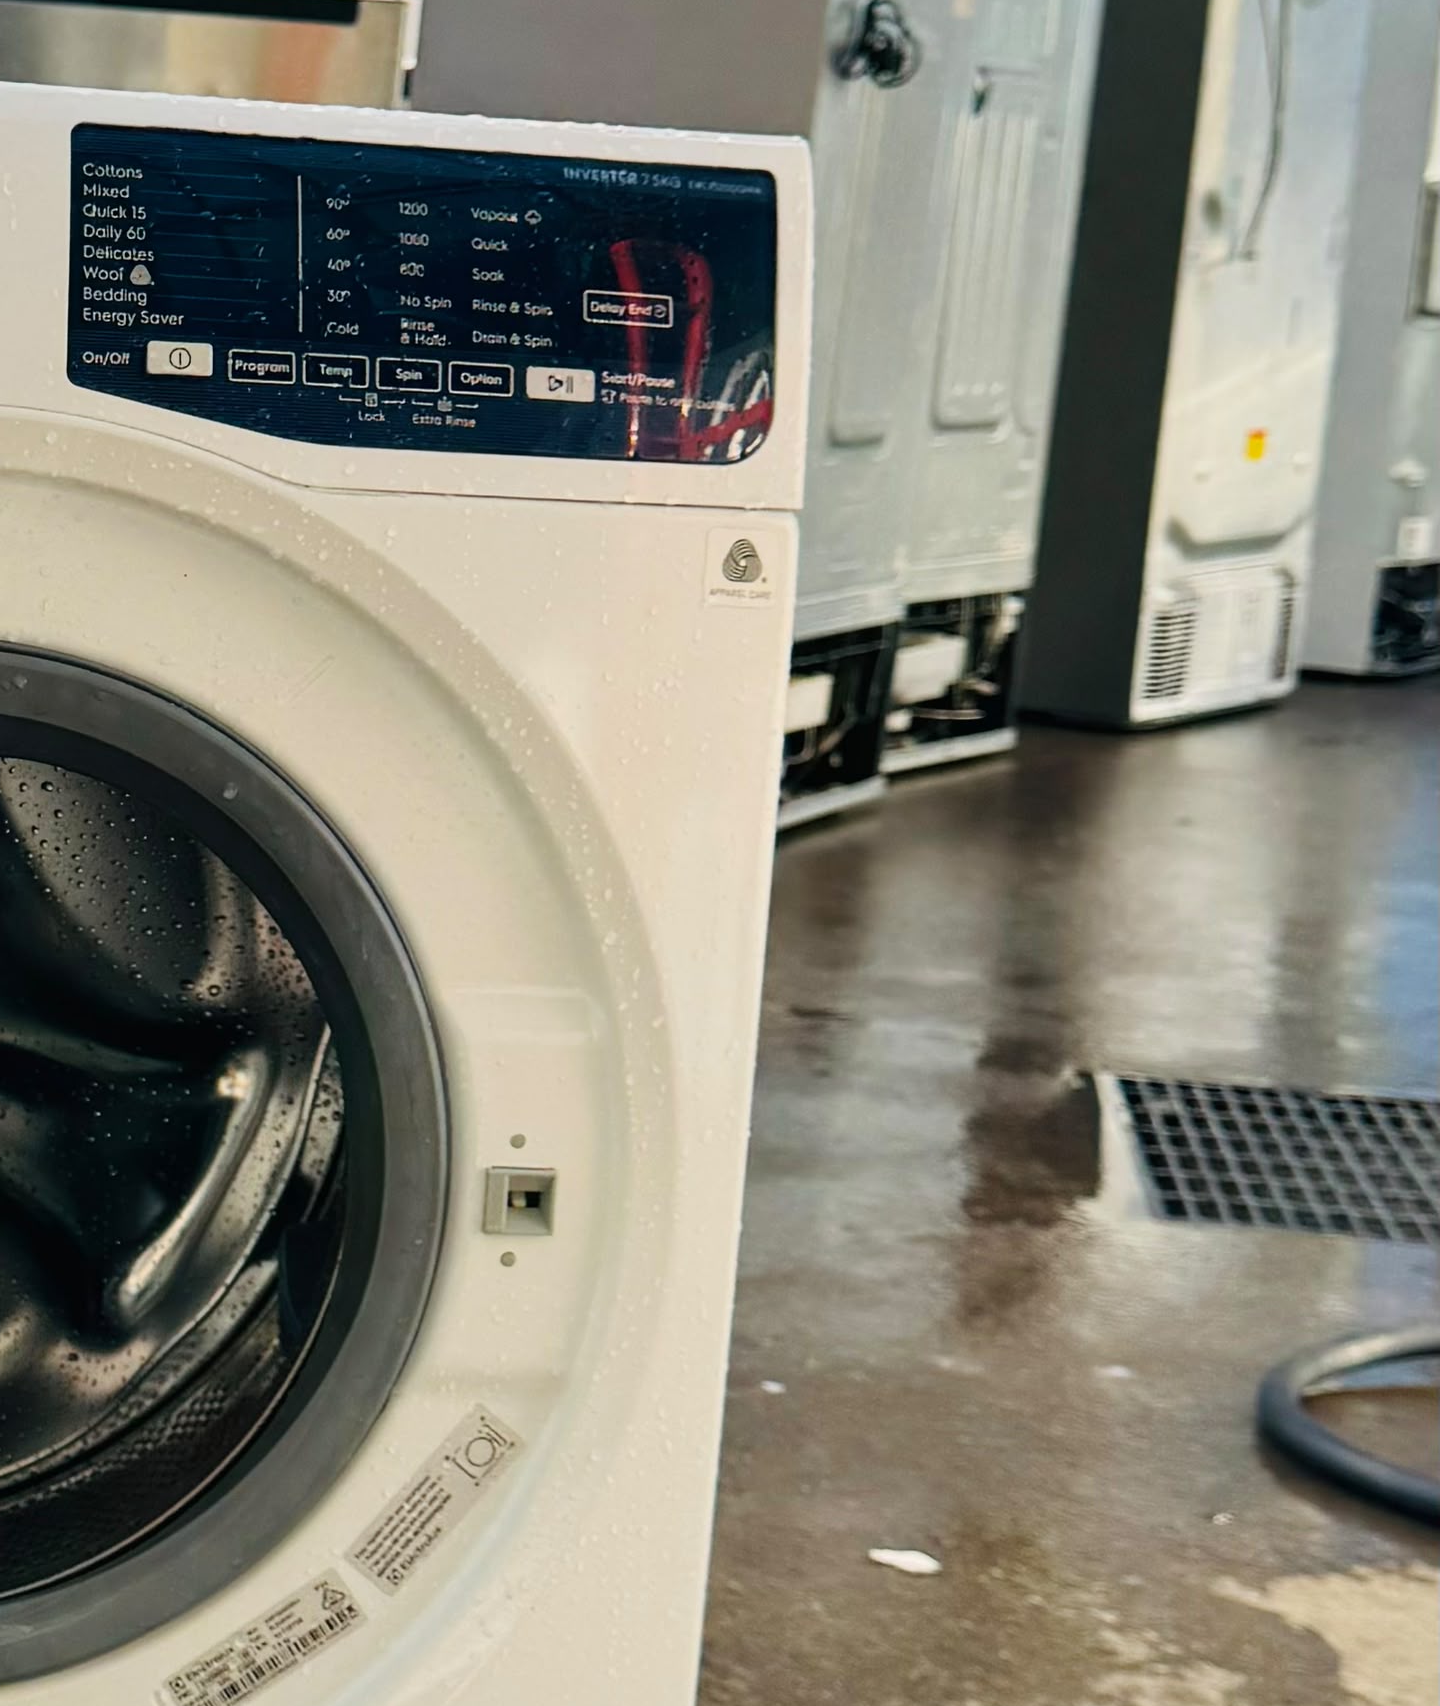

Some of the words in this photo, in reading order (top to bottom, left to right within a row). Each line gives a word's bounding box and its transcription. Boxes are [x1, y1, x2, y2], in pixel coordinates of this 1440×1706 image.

[82, 162, 143, 179] Cottons
[83, 184, 130, 199] Mixed
[82, 203, 127, 219] Quick
[131, 205, 147, 220] 15
[398, 201, 428, 217] 1200
[83, 224, 122, 242] Daily
[126, 226, 147, 241] 60
[471, 237, 510, 253] Quick
[83, 245, 154, 262] Delicates
[471, 268, 505, 282] Soak
[83, 286, 147, 306] Bedding
[399, 294, 421, 308] No
[424, 295, 452, 310] Spin
[471, 299, 508, 314] Rinse
[524, 302, 553, 316] Spin
[590, 301, 626, 316] Delay
[627, 303, 653, 317] End
[82, 307, 136, 327] Energy
[140, 310, 185, 326] Saver
[326, 321, 359, 336] Cold
[472, 330, 508, 345] Drain
[524, 334, 553, 349] Spin
[82, 351, 130, 366] On/Off
[234, 359, 290, 376] Program
[320, 363, 353, 379] Temp
[396, 367, 423, 383] Spin
[460, 371, 503, 387] Option
[601, 371, 676, 389] Start/Pause
[358, 410, 386, 423] Lock
[412, 412, 443, 427] Extra
